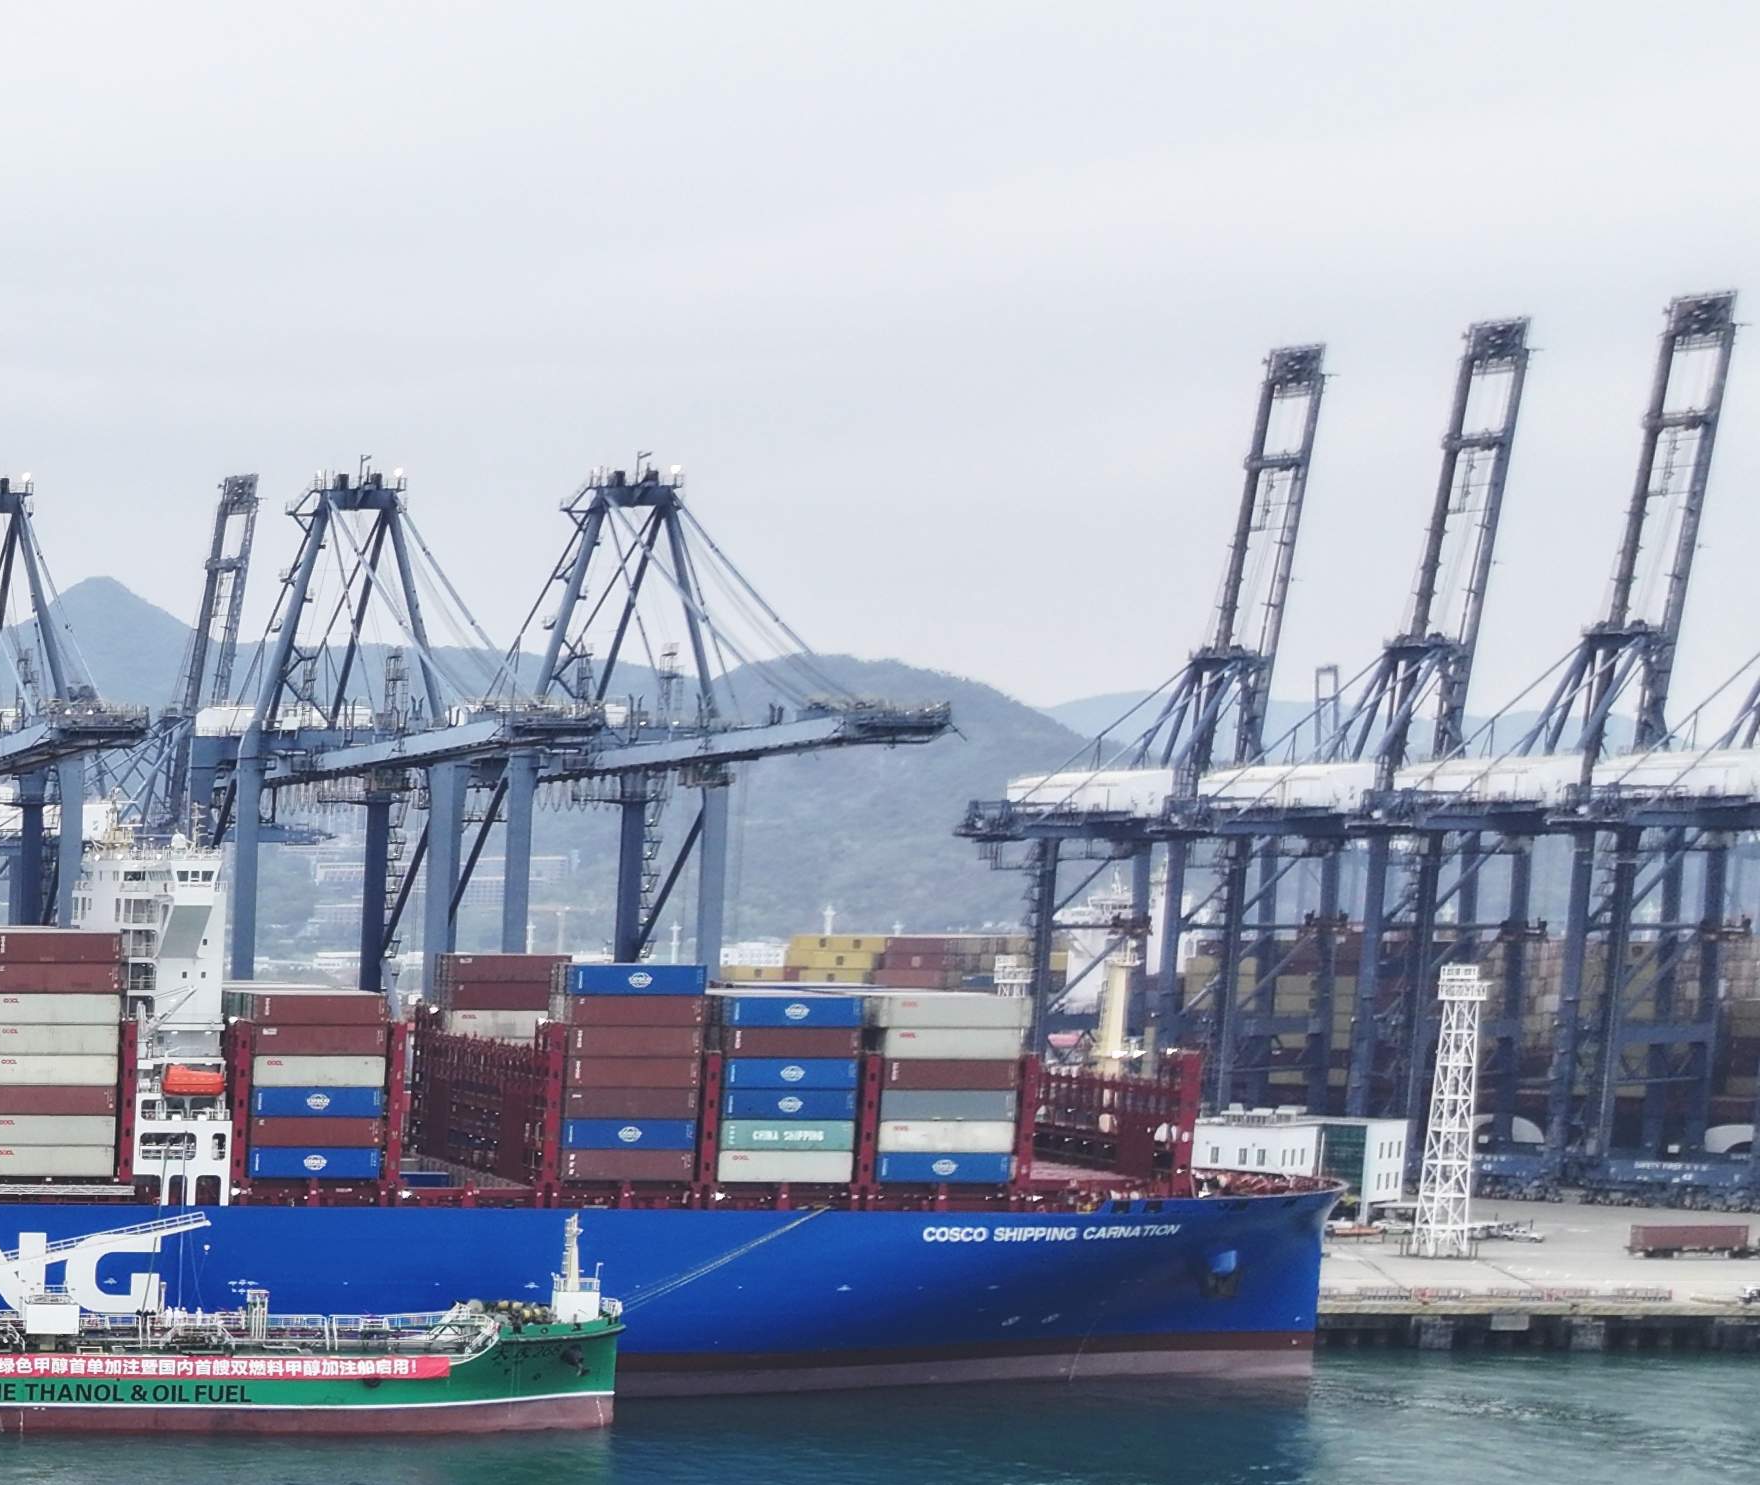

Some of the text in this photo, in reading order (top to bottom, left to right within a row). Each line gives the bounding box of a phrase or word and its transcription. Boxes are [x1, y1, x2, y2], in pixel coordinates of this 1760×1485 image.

[923, 1224, 1182, 1242] COSCO SHIPPING CARNATION
[130, 1384, 147, 1402] &
[152, 1384, 190, 1402] OIL
[195, 1385, 252, 1403] FUEL
